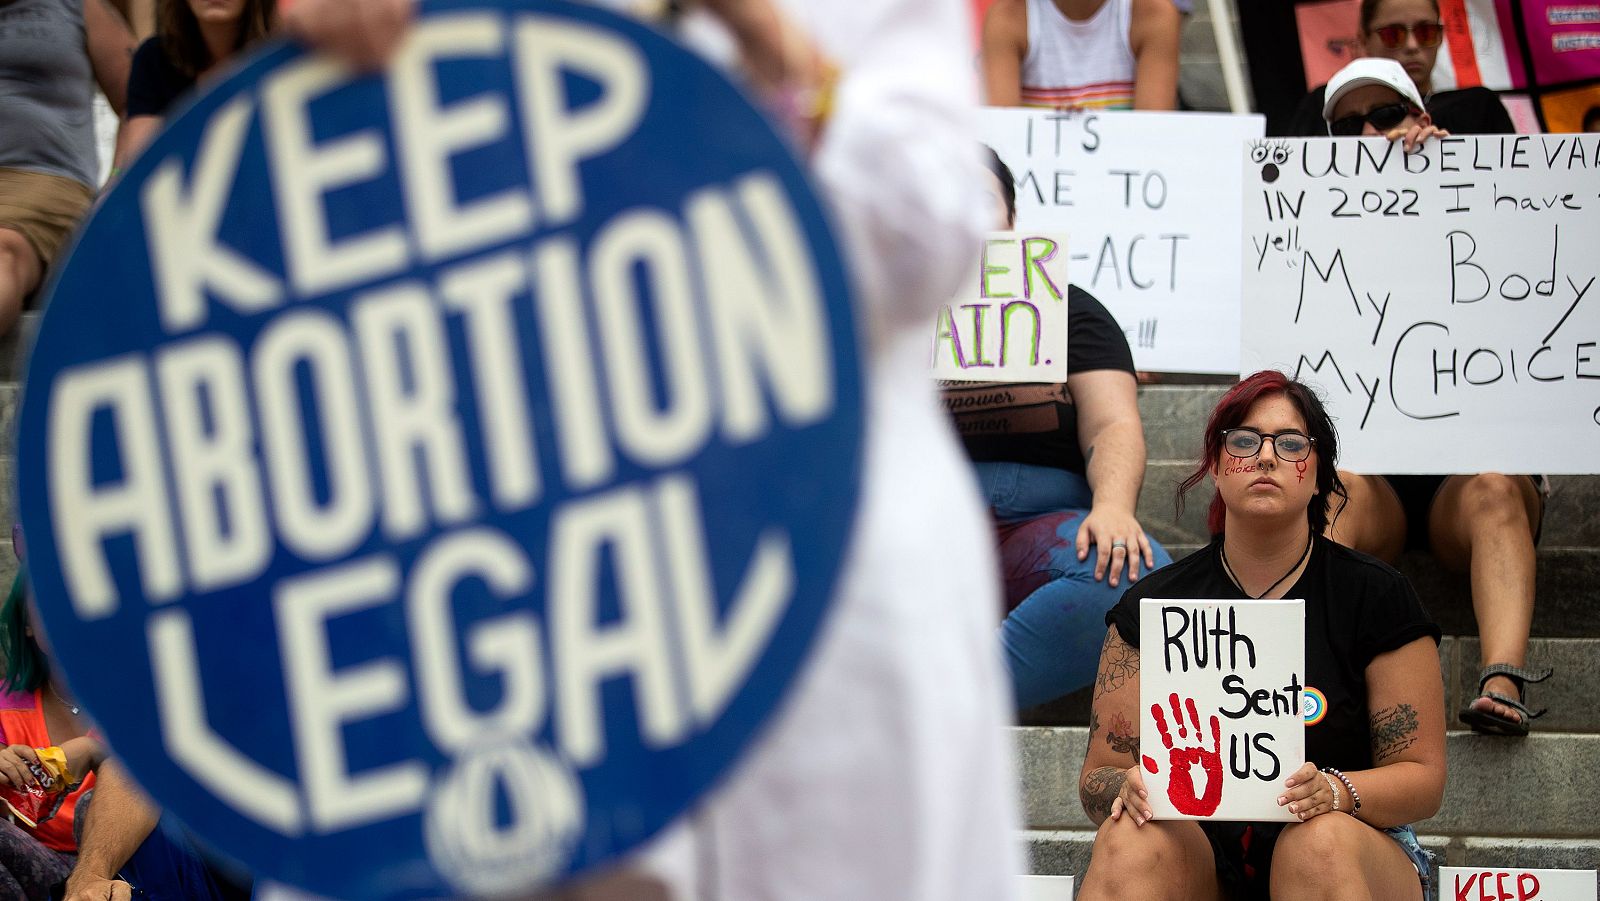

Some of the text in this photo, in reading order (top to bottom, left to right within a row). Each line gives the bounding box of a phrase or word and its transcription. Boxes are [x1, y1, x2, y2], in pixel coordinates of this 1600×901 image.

[141, 14, 652, 332] KEEP
[1012, 168, 1168, 210] ME TO
[1264, 182, 1583, 222] IN 2022 I have
[981, 236, 1064, 302] ER
[1070, 232, 1191, 293] -ACT
[1252, 225, 1301, 272] yell
[1445, 223, 1597, 345] Body
[46, 169, 837, 623] ABORTION
[1295, 321, 1600, 430] My CHOICE
[1224, 464, 1257, 477] CHOICE
[146, 471, 797, 838] LEGAL
[1218, 672, 1303, 720] Sent
[1229, 732, 1281, 782] US
